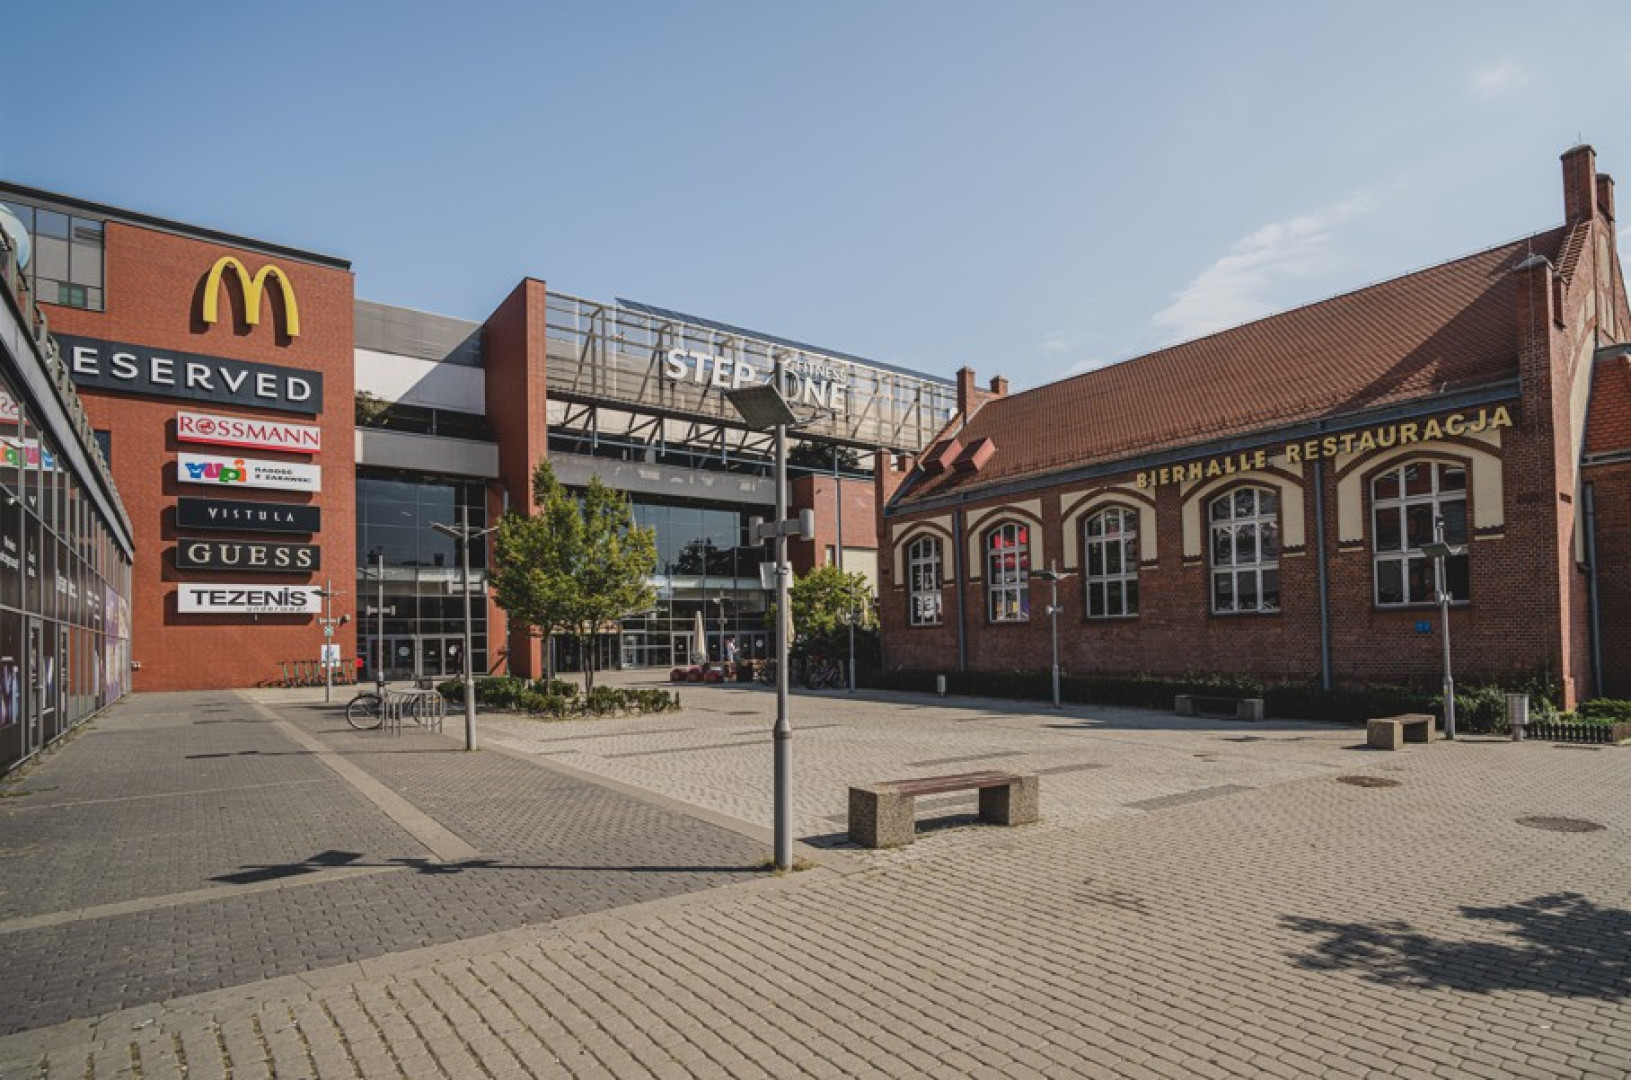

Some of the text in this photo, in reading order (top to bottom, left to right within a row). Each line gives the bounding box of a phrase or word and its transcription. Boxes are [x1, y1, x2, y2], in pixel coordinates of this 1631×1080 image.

[73, 346, 312, 401] ESERVED
[666, 348, 757, 389] STEP
[180, 416, 319, 445] ROSSMANN
[1136, 405, 1513, 489] BIERHALLE RESTAURACJA
[208, 507, 294, 522] VISTULA
[187, 543, 312, 567] GUESS
